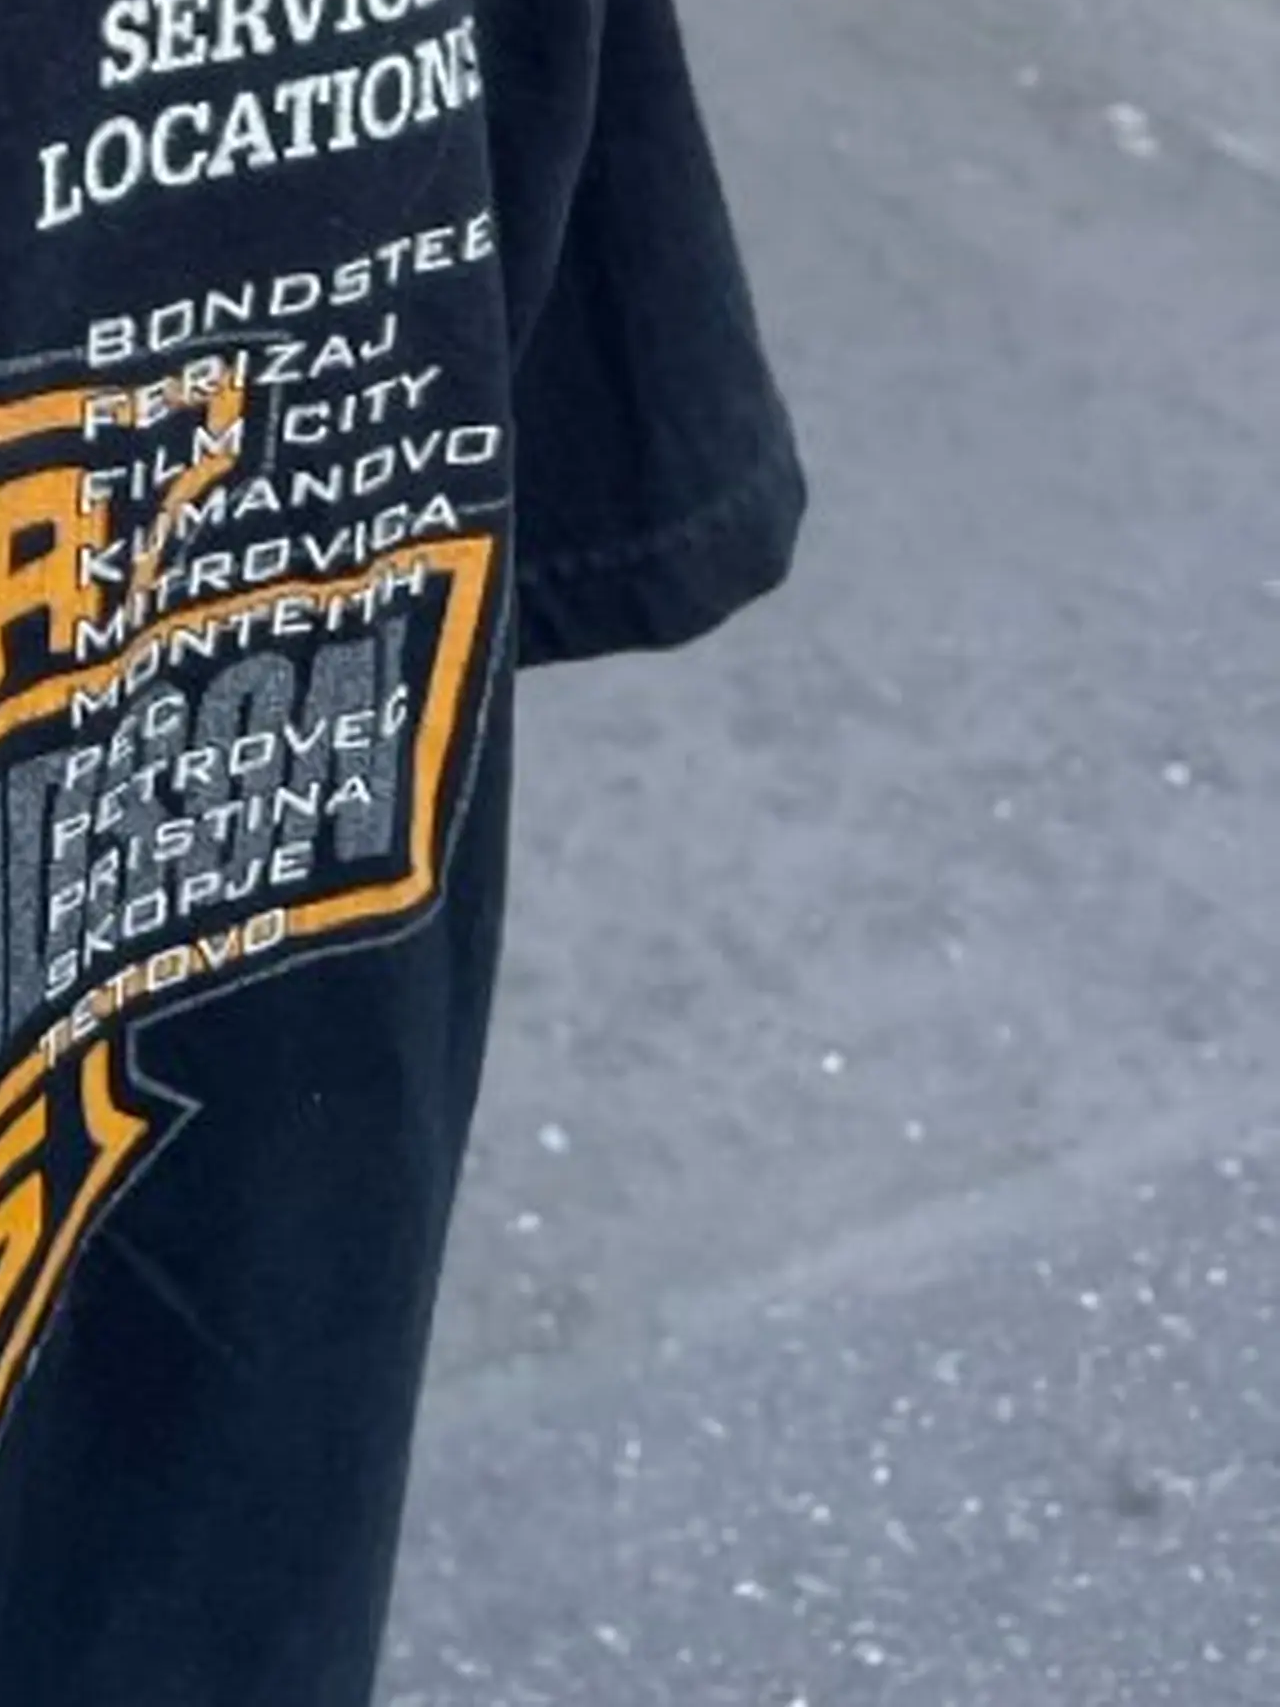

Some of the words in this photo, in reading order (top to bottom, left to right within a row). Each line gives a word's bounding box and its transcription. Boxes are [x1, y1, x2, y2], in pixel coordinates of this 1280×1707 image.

[82, 418, 243, 515] FILM
[283, 365, 441, 444] CITY
[83, 314, 397, 441] FERIZAJ
[76, 493, 460, 661] MITROVICA
[79, 425, 501, 585] KUMANOVO
[71, 555, 425, 729] MONTEITH
[53, 683, 409, 861] PETROVEC
[65, 693, 186, 791] PEC
[46, 842, 313, 1001] SKOPJE
[50, 776, 373, 932] PRISTINA
[40, 908, 286, 1069] TETOVO
